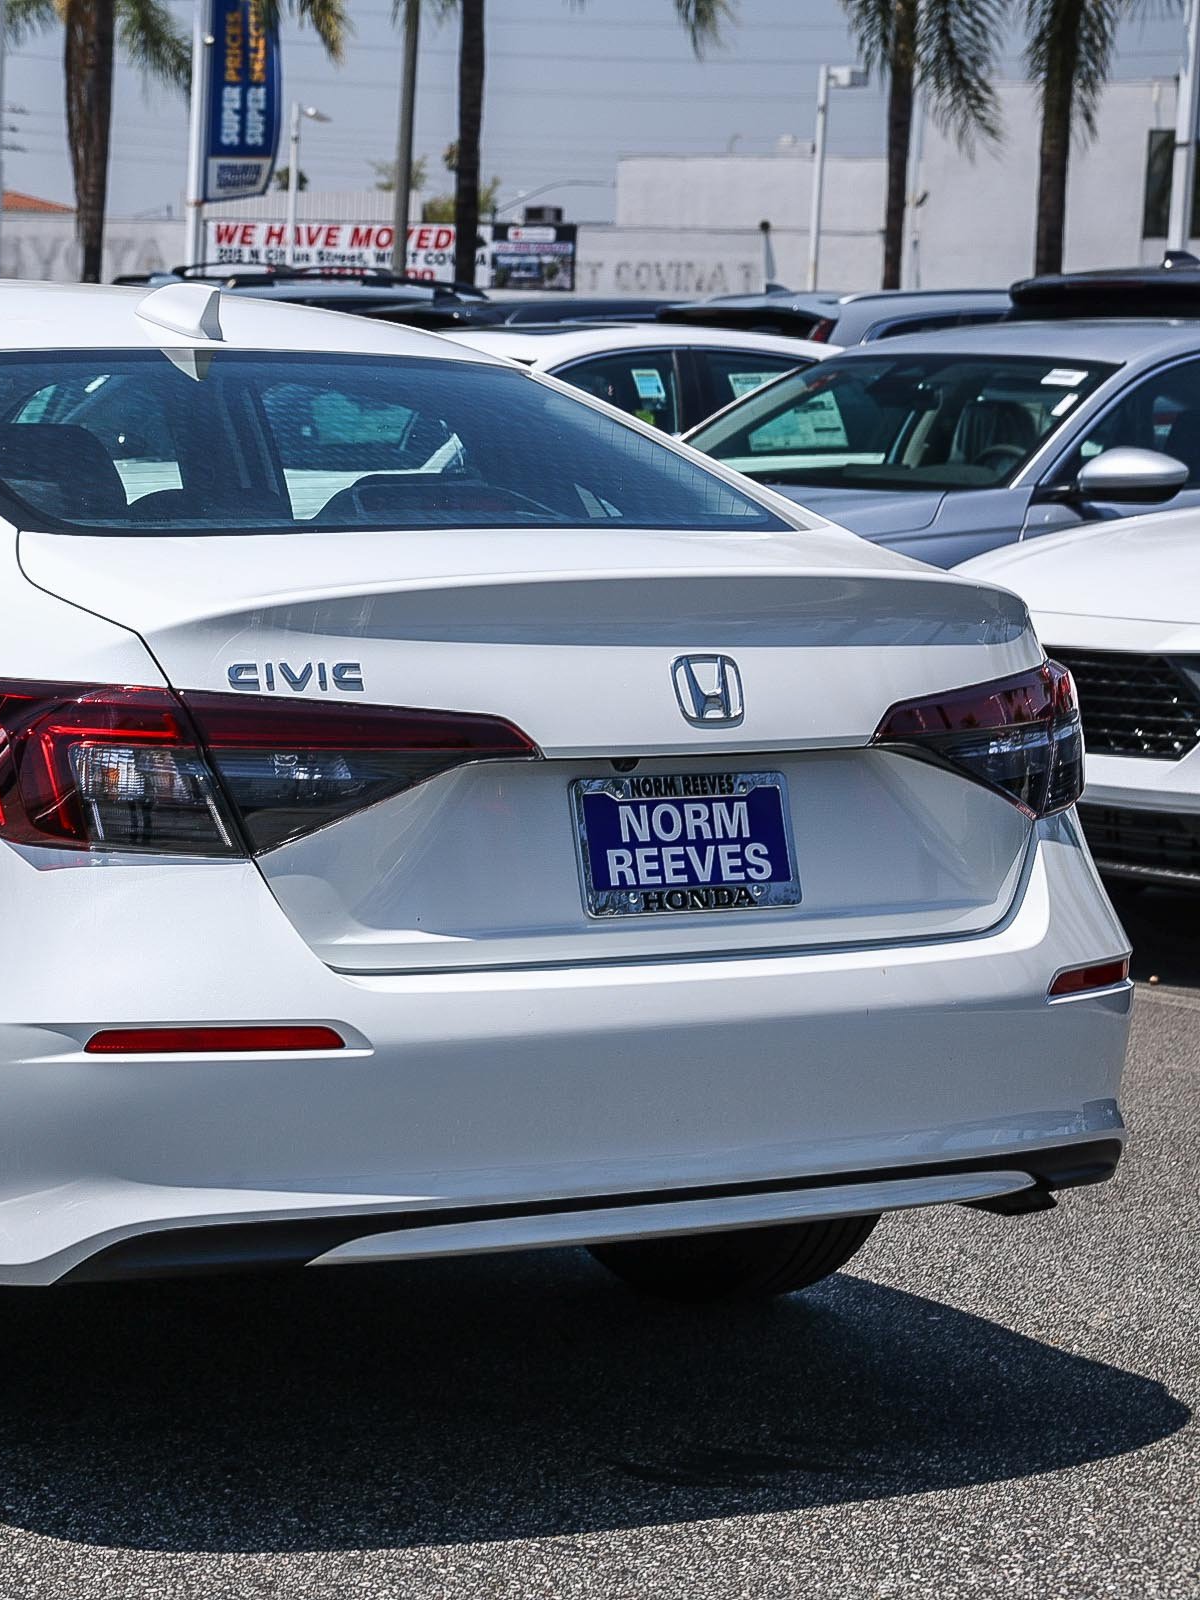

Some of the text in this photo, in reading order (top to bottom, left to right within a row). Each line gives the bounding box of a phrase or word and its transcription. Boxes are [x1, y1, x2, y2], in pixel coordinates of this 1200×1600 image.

[225, 11, 243, 82] PRICES
[220, 86, 242, 146] SUPER
[245, 86, 267, 146] SUPER
[216, 224, 256, 245] WE
[265, 225, 340, 247] HAVE
[227, 662, 365, 692] CIVIC
[629, 774, 735, 798] NORM REEVES
[618, 801, 751, 843] NORM
[606, 842, 773, 887] REEVES
[640, 886, 759, 912] HONDA
